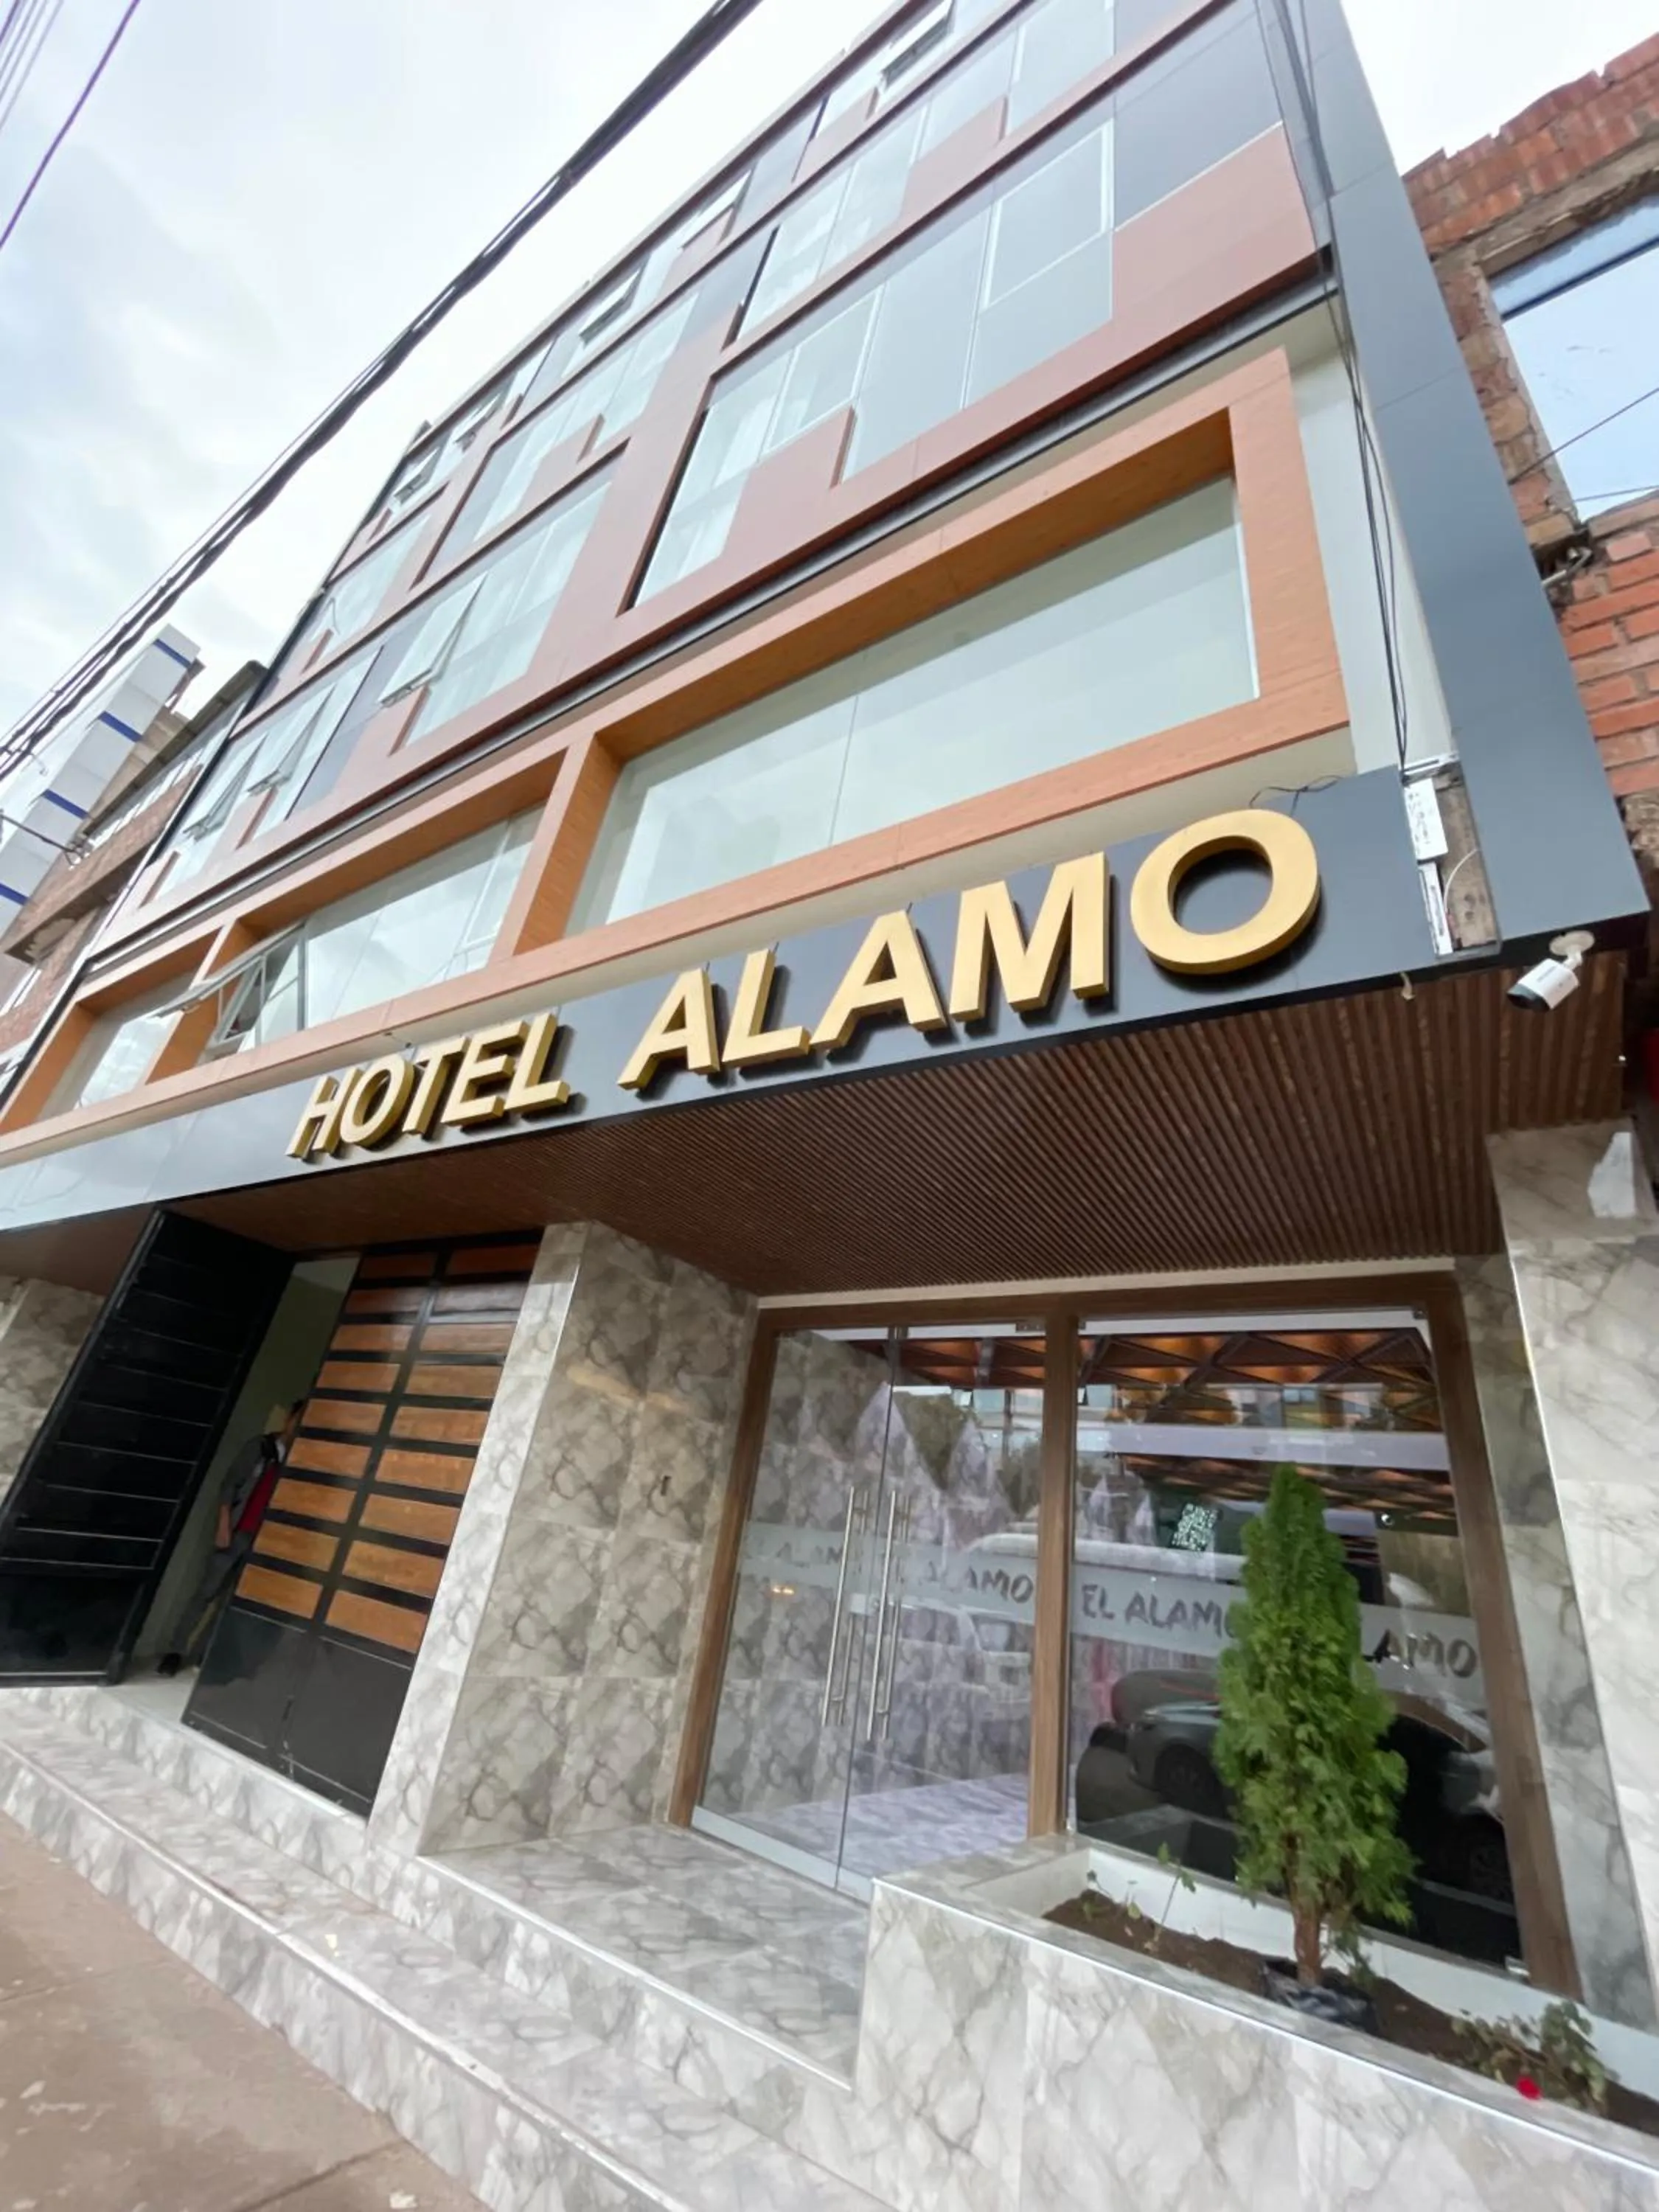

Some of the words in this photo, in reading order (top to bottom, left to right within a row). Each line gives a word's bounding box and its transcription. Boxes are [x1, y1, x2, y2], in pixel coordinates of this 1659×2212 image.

[285, 1012, 570, 1159] HOTEL
[617, 809, 1320, 1091] ALAMO
[1082, 1584, 1115, 1619] EL
[1124, 1590, 1234, 1638] ALAM
